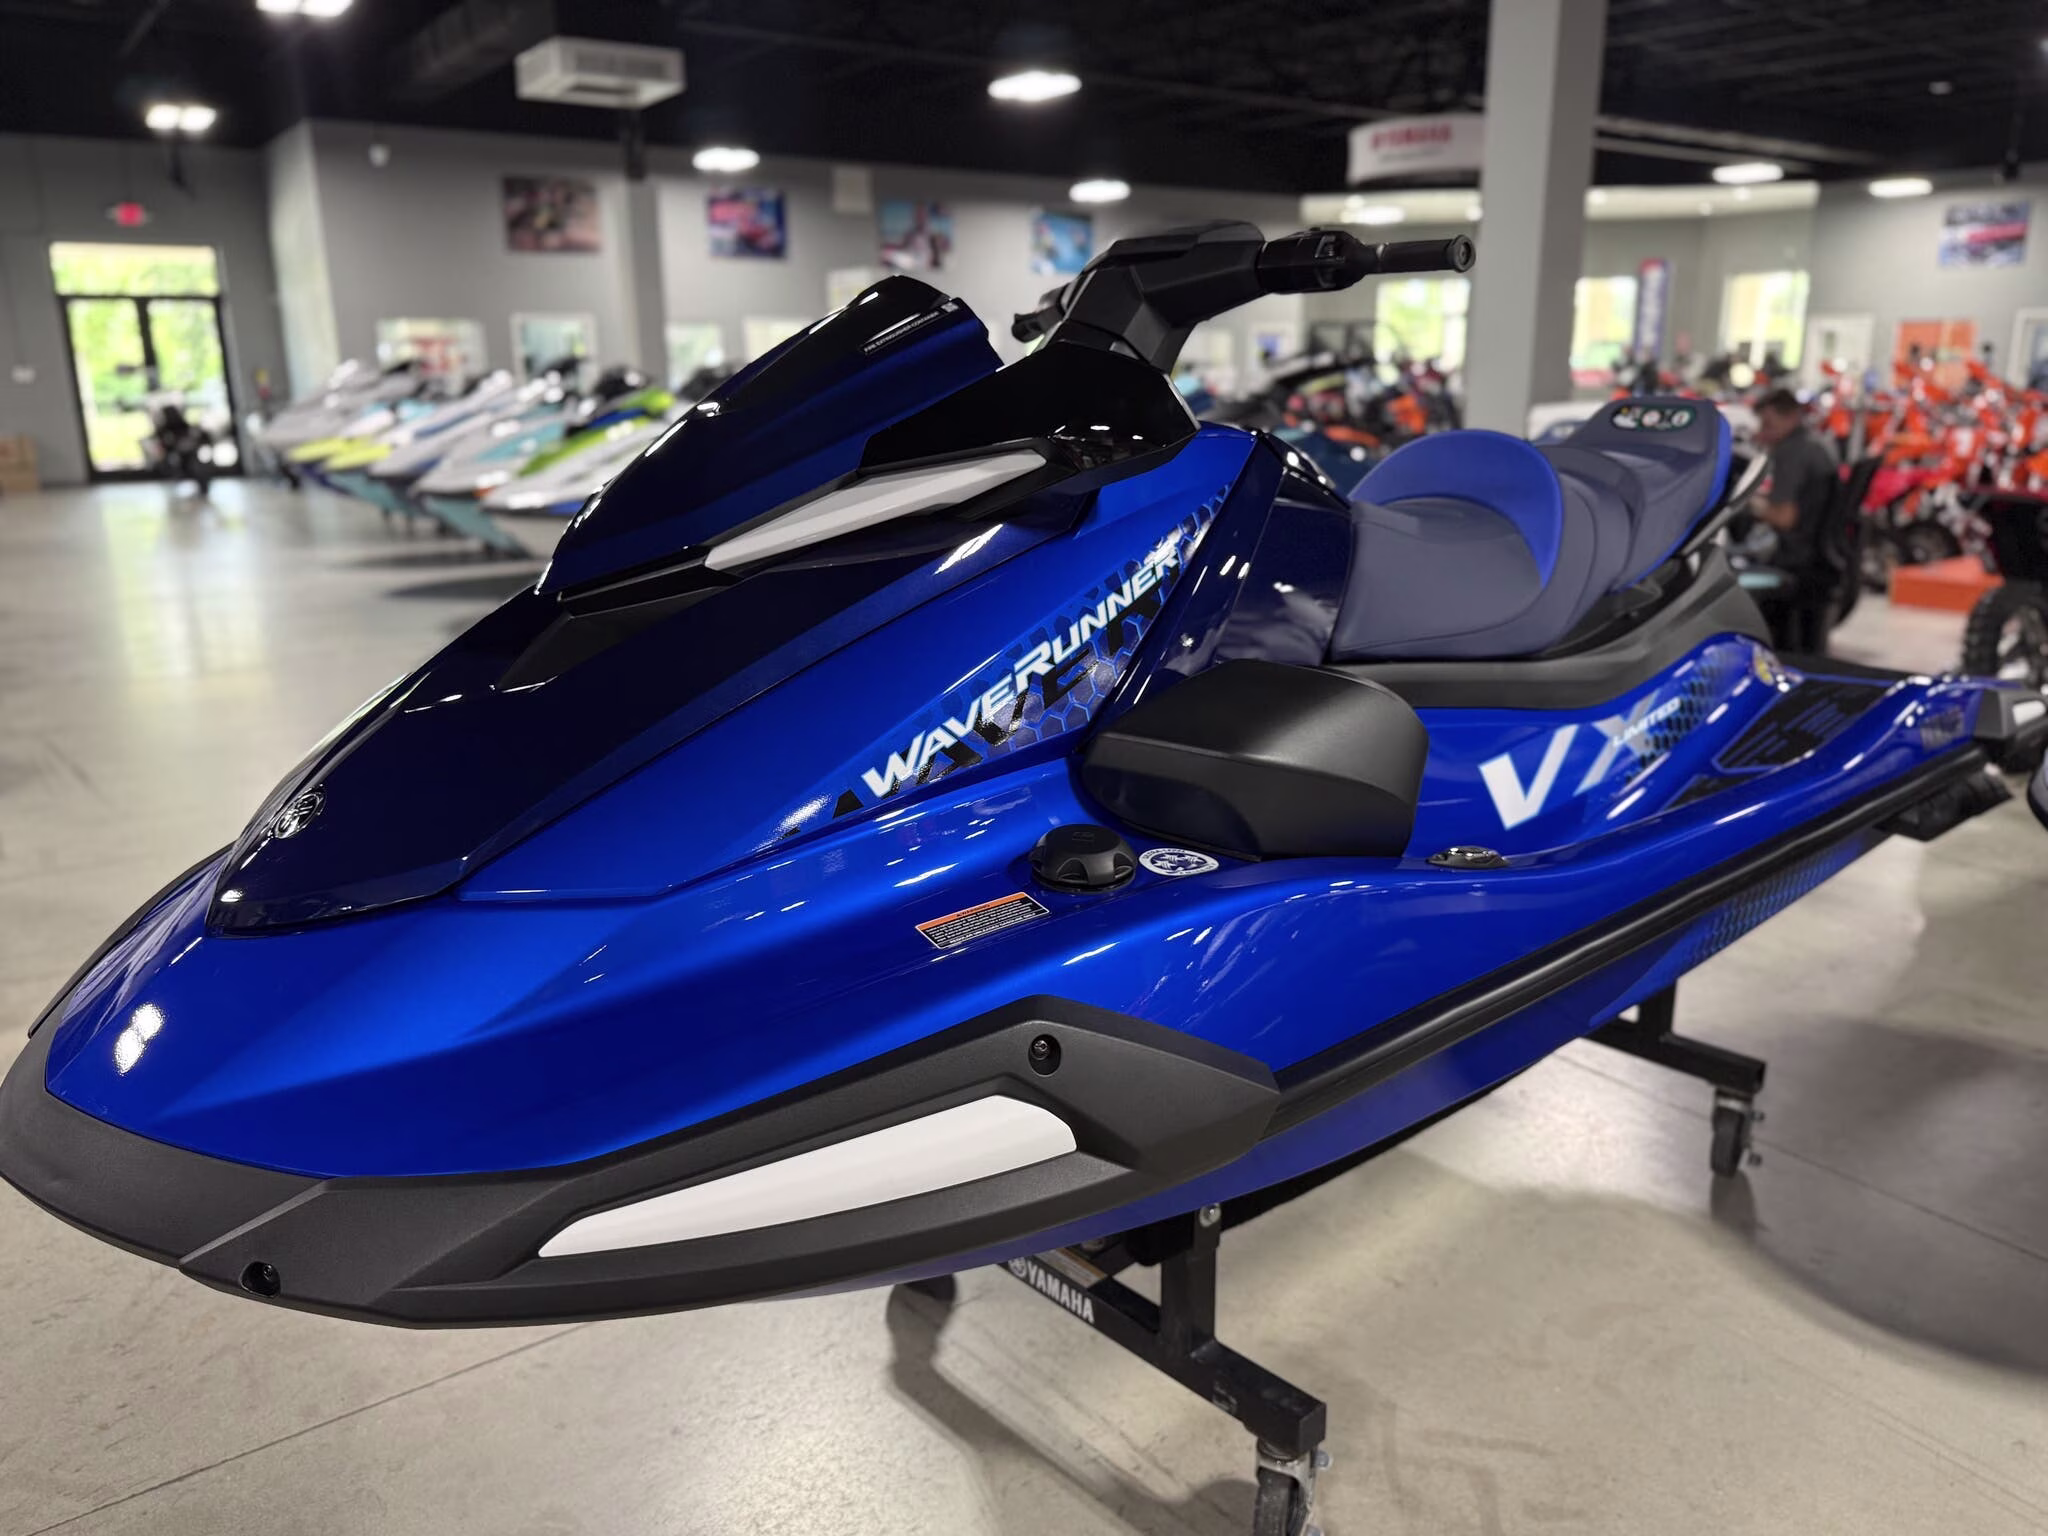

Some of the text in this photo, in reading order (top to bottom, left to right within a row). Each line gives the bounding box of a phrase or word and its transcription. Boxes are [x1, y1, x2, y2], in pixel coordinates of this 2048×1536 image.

[861, 551, 1180, 798] WAVERUNNER
[1612, 696, 1681, 748] LIMITED
[1477, 688, 1661, 831] VX
[1027, 1260, 1095, 1325] YAMAHA
